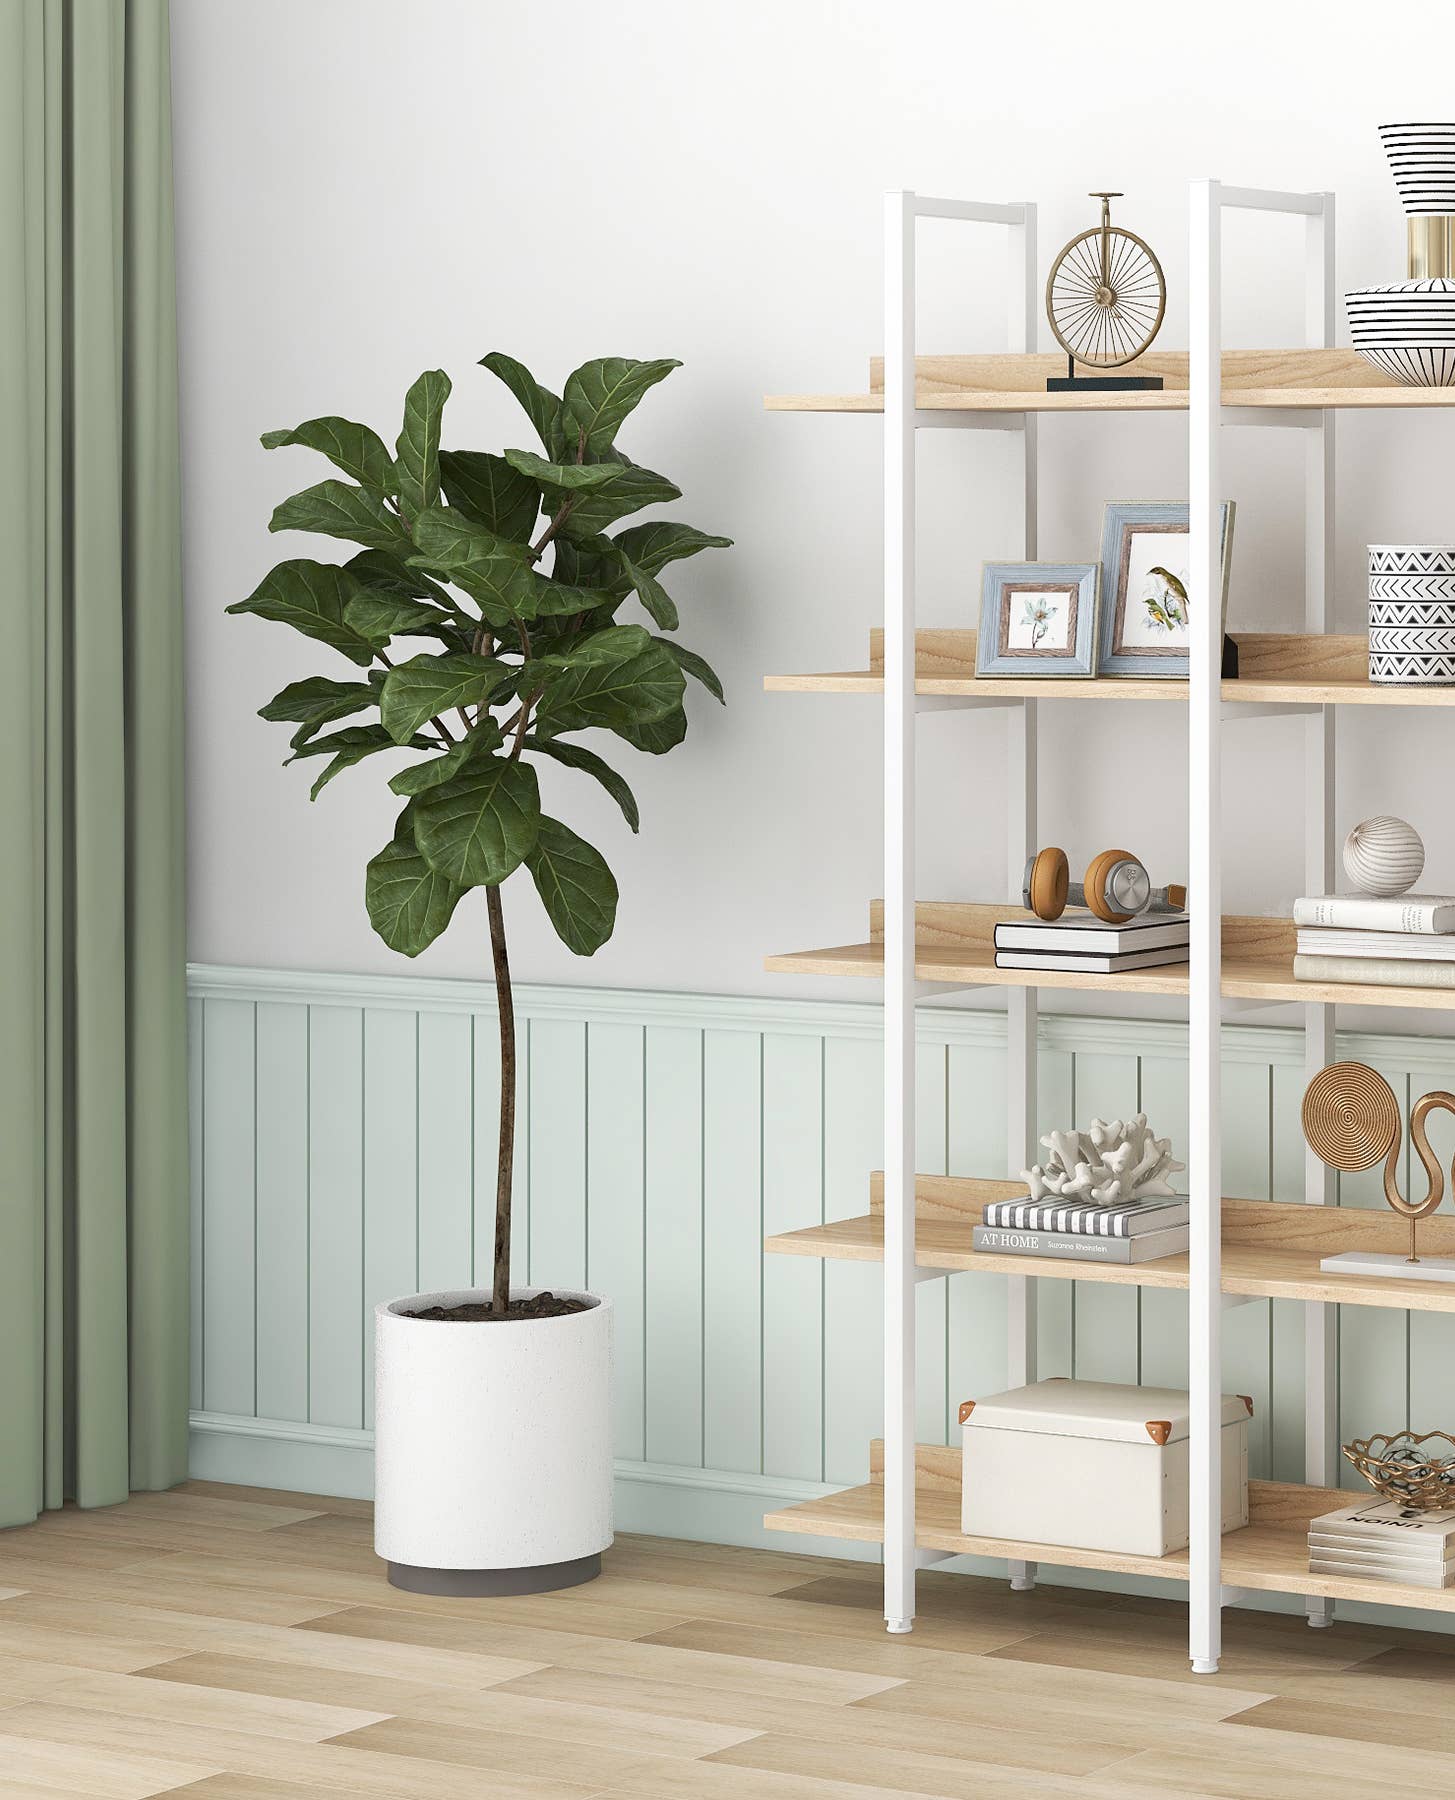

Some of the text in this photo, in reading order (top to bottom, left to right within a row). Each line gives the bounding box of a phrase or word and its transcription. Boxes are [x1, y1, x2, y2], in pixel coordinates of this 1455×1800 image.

[980, 1233, 999, 1246] AT
[1001, 1234, 1039, 1249] HOME
[1047, 1240, 1075, 1251] Suzanne
[1346, 1516, 1424, 1529] UNION
